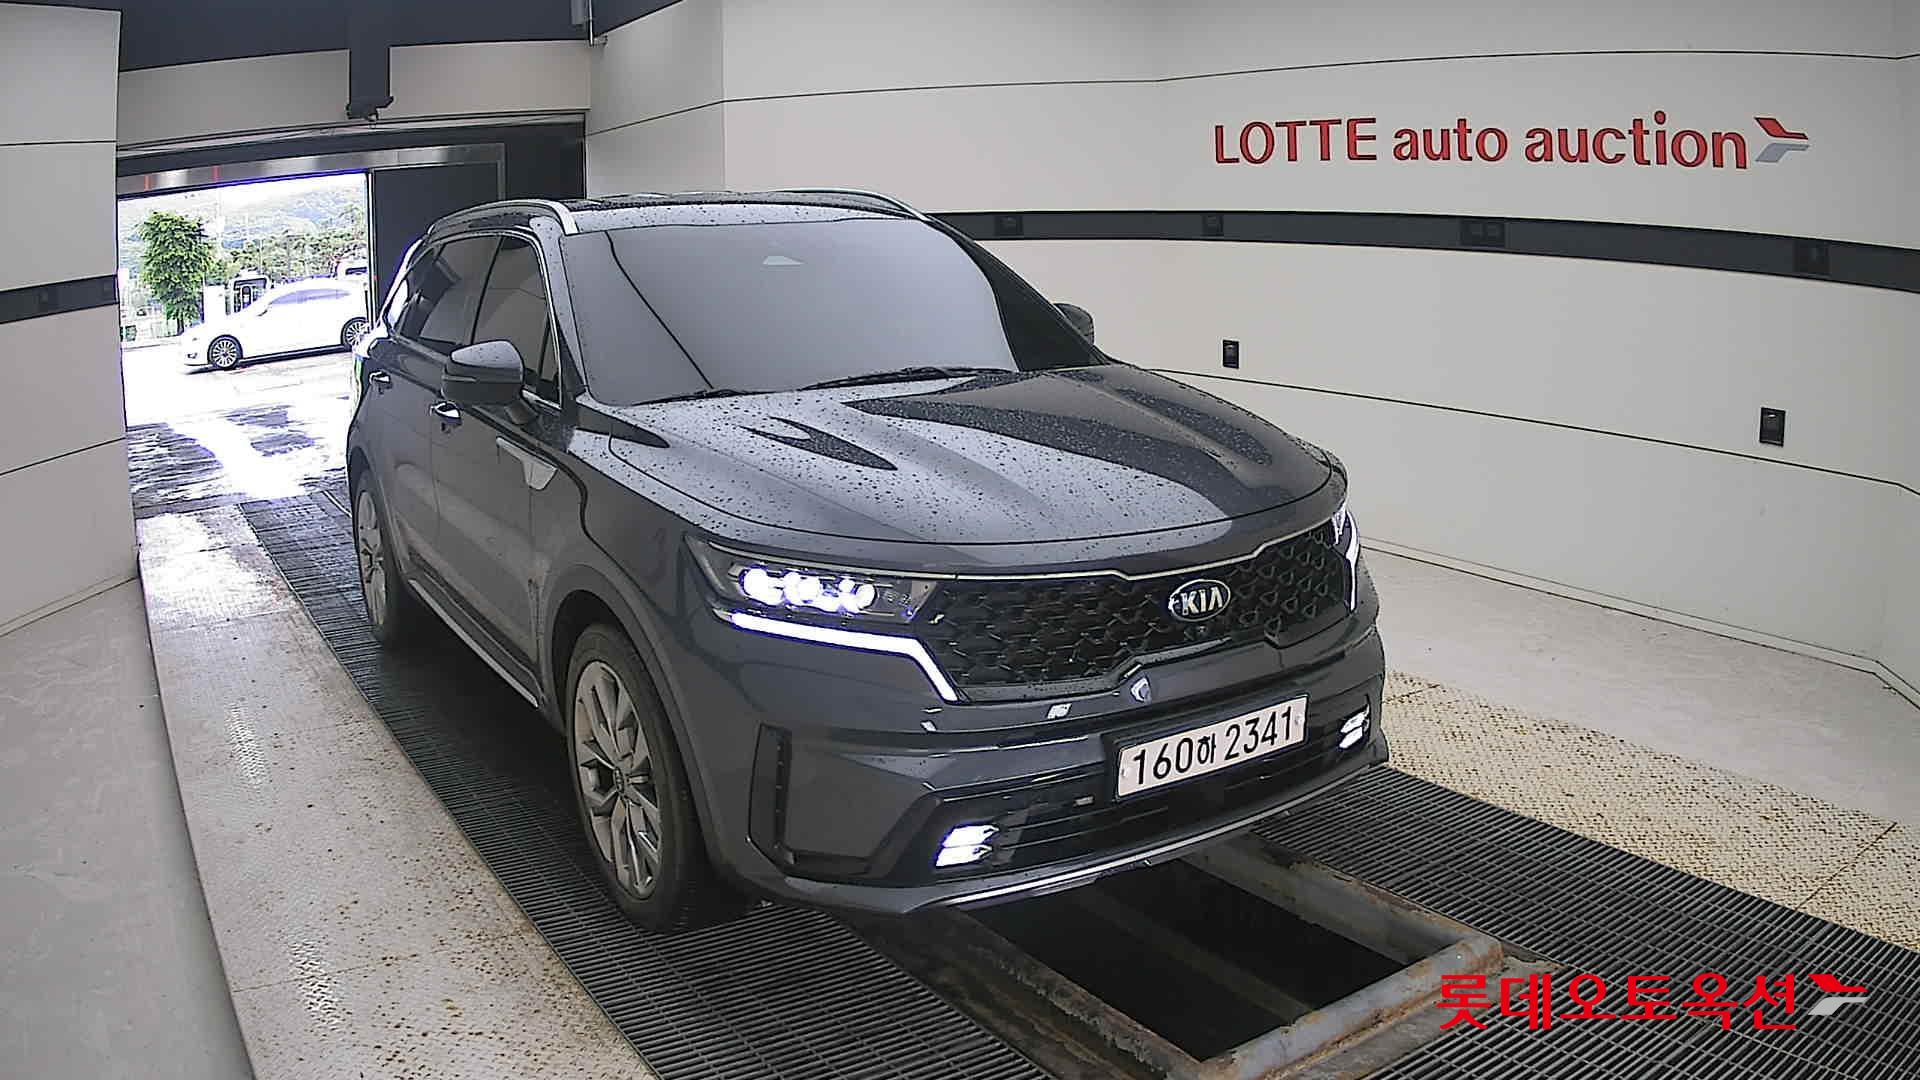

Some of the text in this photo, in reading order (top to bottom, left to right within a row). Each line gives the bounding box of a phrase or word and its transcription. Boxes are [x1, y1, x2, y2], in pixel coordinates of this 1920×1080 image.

[1214, 110, 1748, 169] LOTTE auto auction
[1182, 586, 1223, 616] KIA
[1133, 706, 1292, 785] 160하 2341
